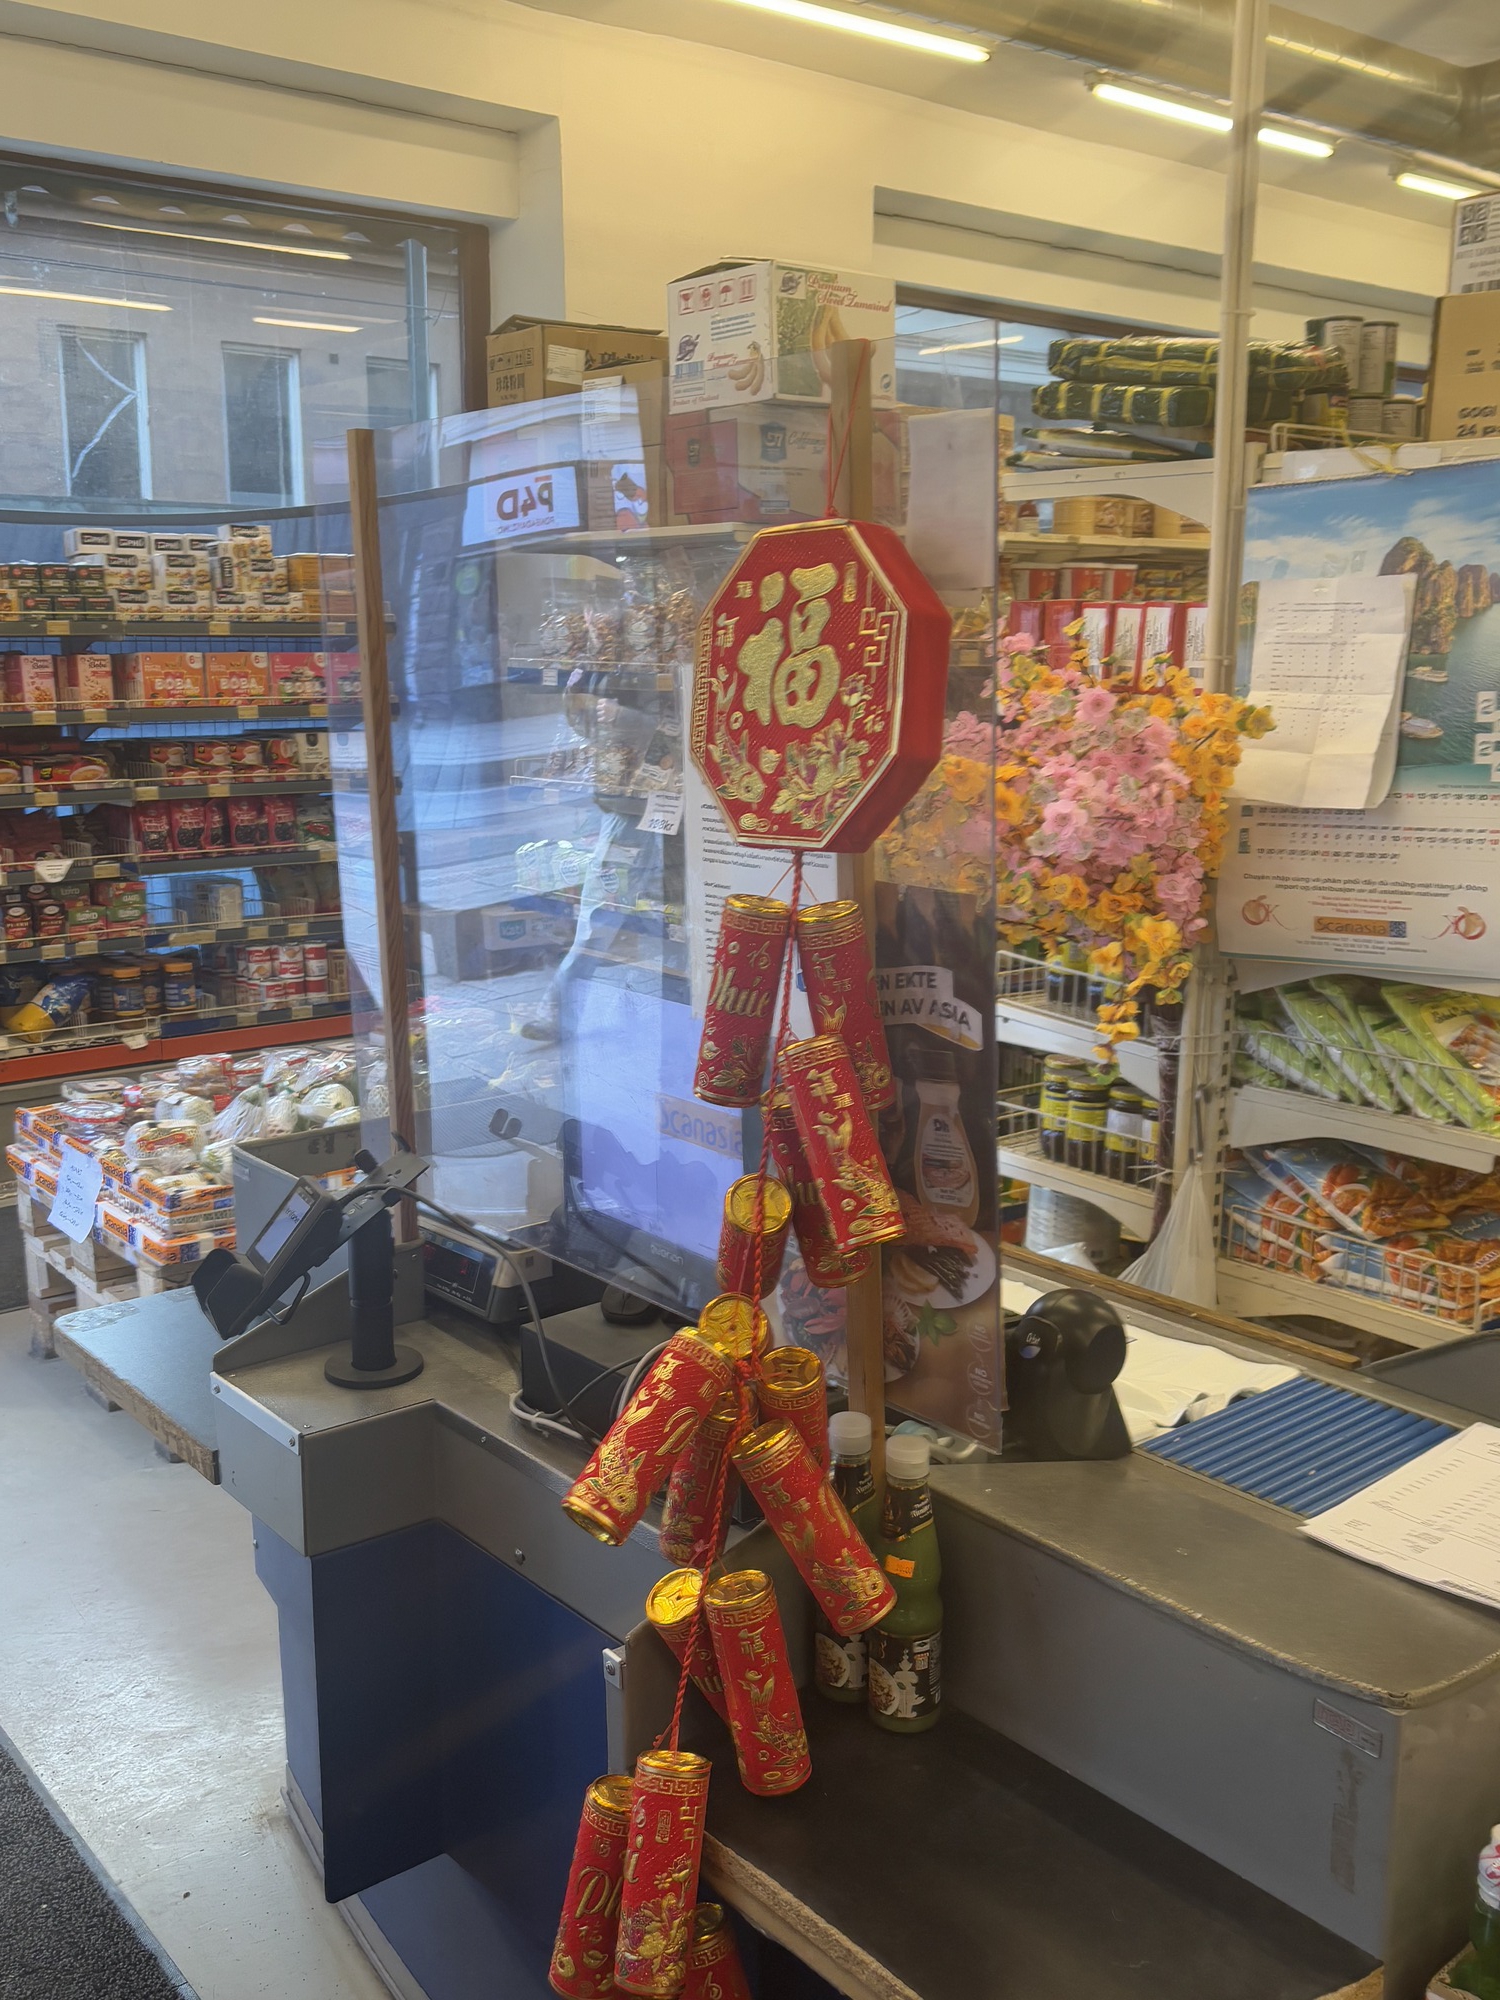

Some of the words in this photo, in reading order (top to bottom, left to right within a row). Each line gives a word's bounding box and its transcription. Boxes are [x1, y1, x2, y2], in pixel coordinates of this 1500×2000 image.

[807, 272, 852, 293] Premium
[845, 291, 893, 312] Tamarind
[737, 562, 841, 729] 福
[155, 677, 192, 690] BOBA
[219, 677, 258, 689] BOBA
[895, 971, 937, 990] EKTE
[901, 999, 925, 1017] AV
[929, 999, 971, 1031] ASIA
